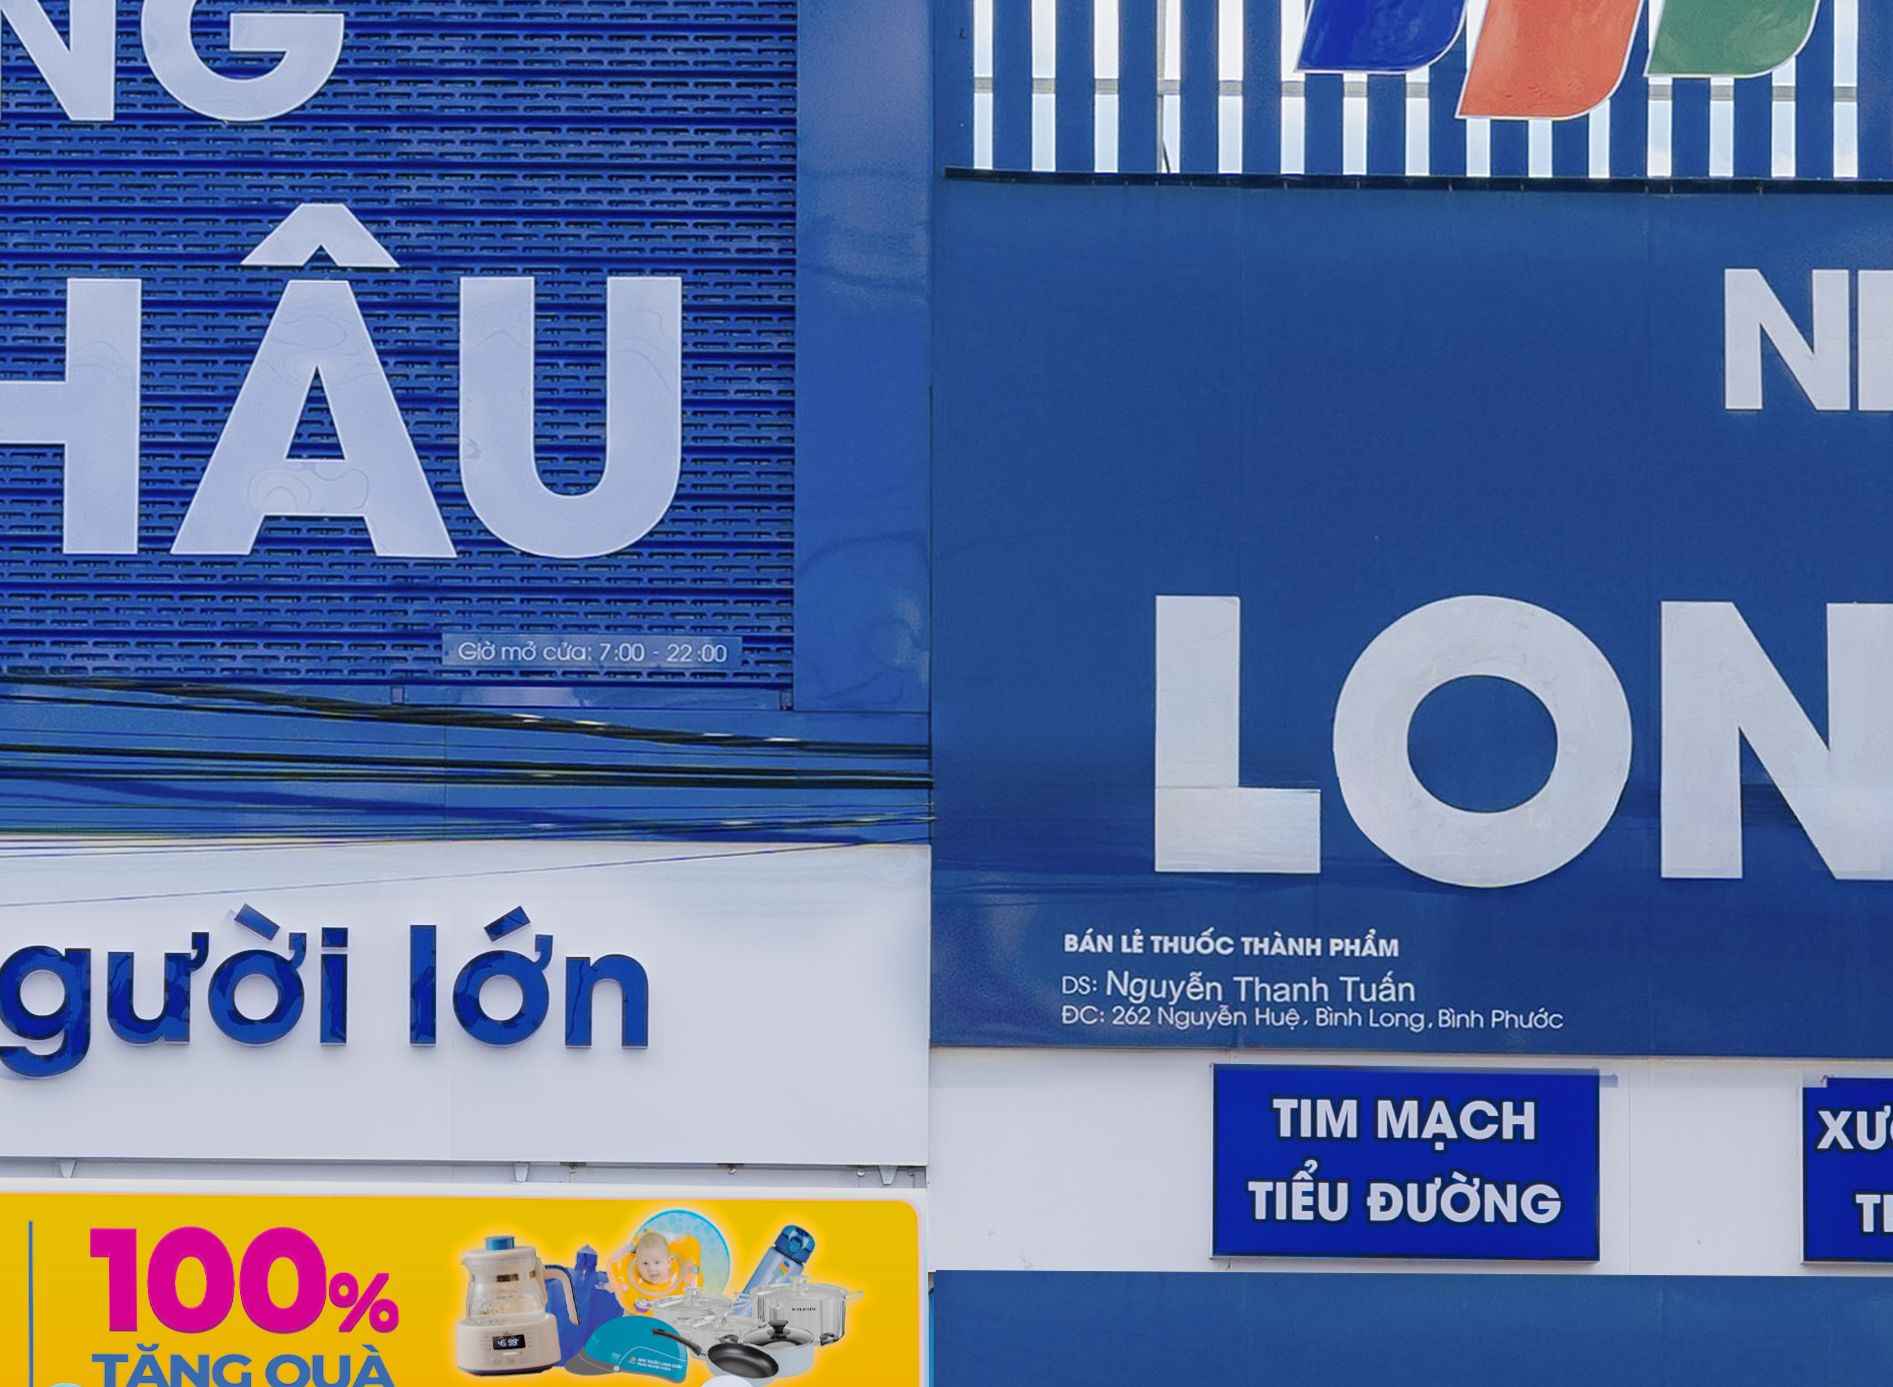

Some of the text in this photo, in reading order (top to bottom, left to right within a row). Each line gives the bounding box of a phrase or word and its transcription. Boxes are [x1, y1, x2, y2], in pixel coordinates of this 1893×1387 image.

[458, 640, 496, 661] Giờ
[501, 640, 537, 661] mở
[543, 639, 592, 661] cửa:
[1063, 928, 1399, 957] BÁN LẺ THUỐC THÀNH PHẨM
[409, 905, 652, 1051] lớn
[1062, 970, 1416, 1004] DS: Nguyễn Thanh Tuấn
[1061, 1007, 1105, 1025] ĐC:
[1112, 1007, 1151, 1025] 262
[1158, 1005, 1247, 1030] Nguyễn
[1316, 1006, 1365, 1027] Bình
[1439, 1009, 1485, 1028] Bình
[1491, 1009, 1564, 1029] Phước
[1273, 1098, 1537, 1145] TIM MẠCH
[1248, 1159, 1562, 1225] TIỂU ĐƯỜNG
[90, 1224, 401, 1338] 100%
